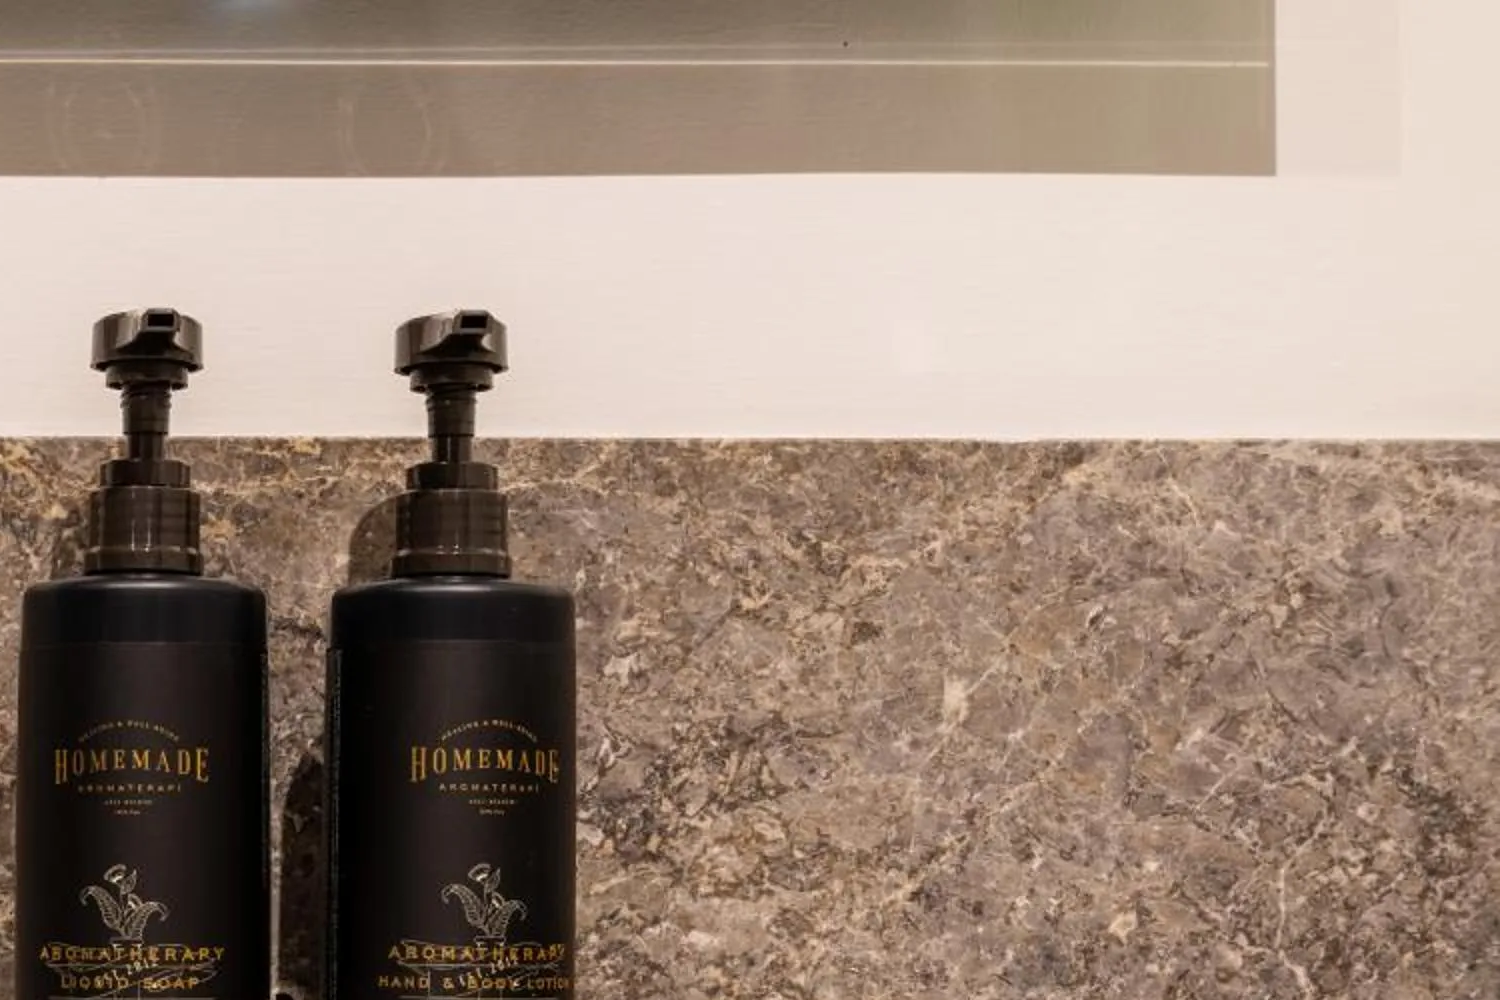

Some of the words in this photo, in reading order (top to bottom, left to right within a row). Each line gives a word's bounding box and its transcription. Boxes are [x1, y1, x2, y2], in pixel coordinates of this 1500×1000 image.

[54, 747, 210, 785] HOMEMADE
[409, 746, 562, 784] HOMEMADE
[39, 946, 225, 961] AROMATHERAPY
[60, 976, 130, 990] LIQUID
[143, 976, 201, 990] SOAP
[378, 975, 430, 989] HAND
[442, 976, 456, 989] &
